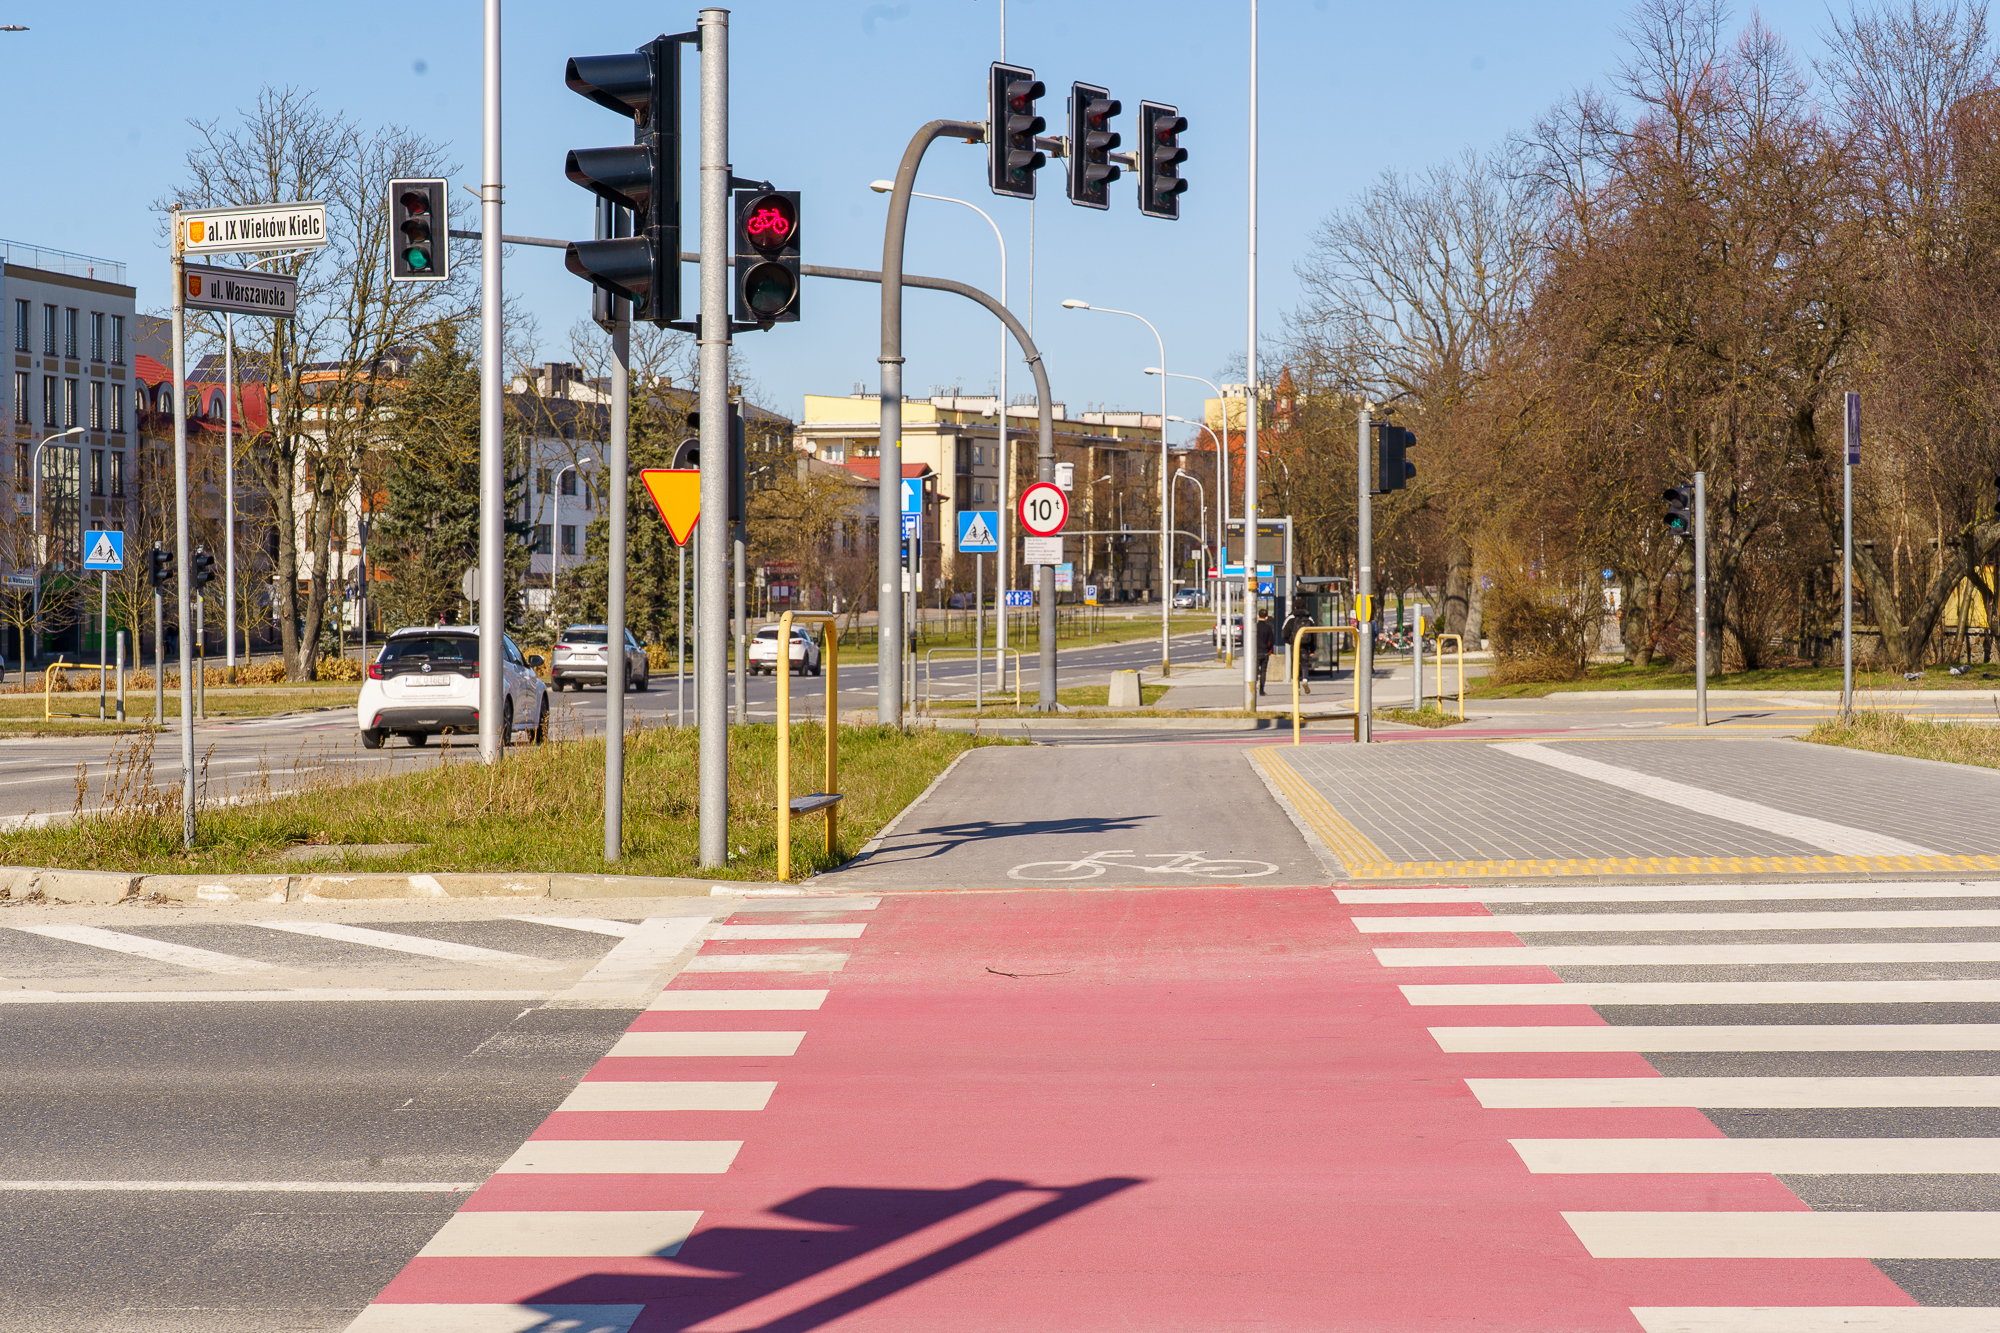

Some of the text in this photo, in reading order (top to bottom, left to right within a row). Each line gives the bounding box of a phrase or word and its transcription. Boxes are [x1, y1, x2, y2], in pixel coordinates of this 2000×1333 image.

[208, 214, 320, 242] al. IX Wieków Kielc
[211, 279, 285, 307] ul. Warszawska
[1030, 499, 1060, 521] 10 t
